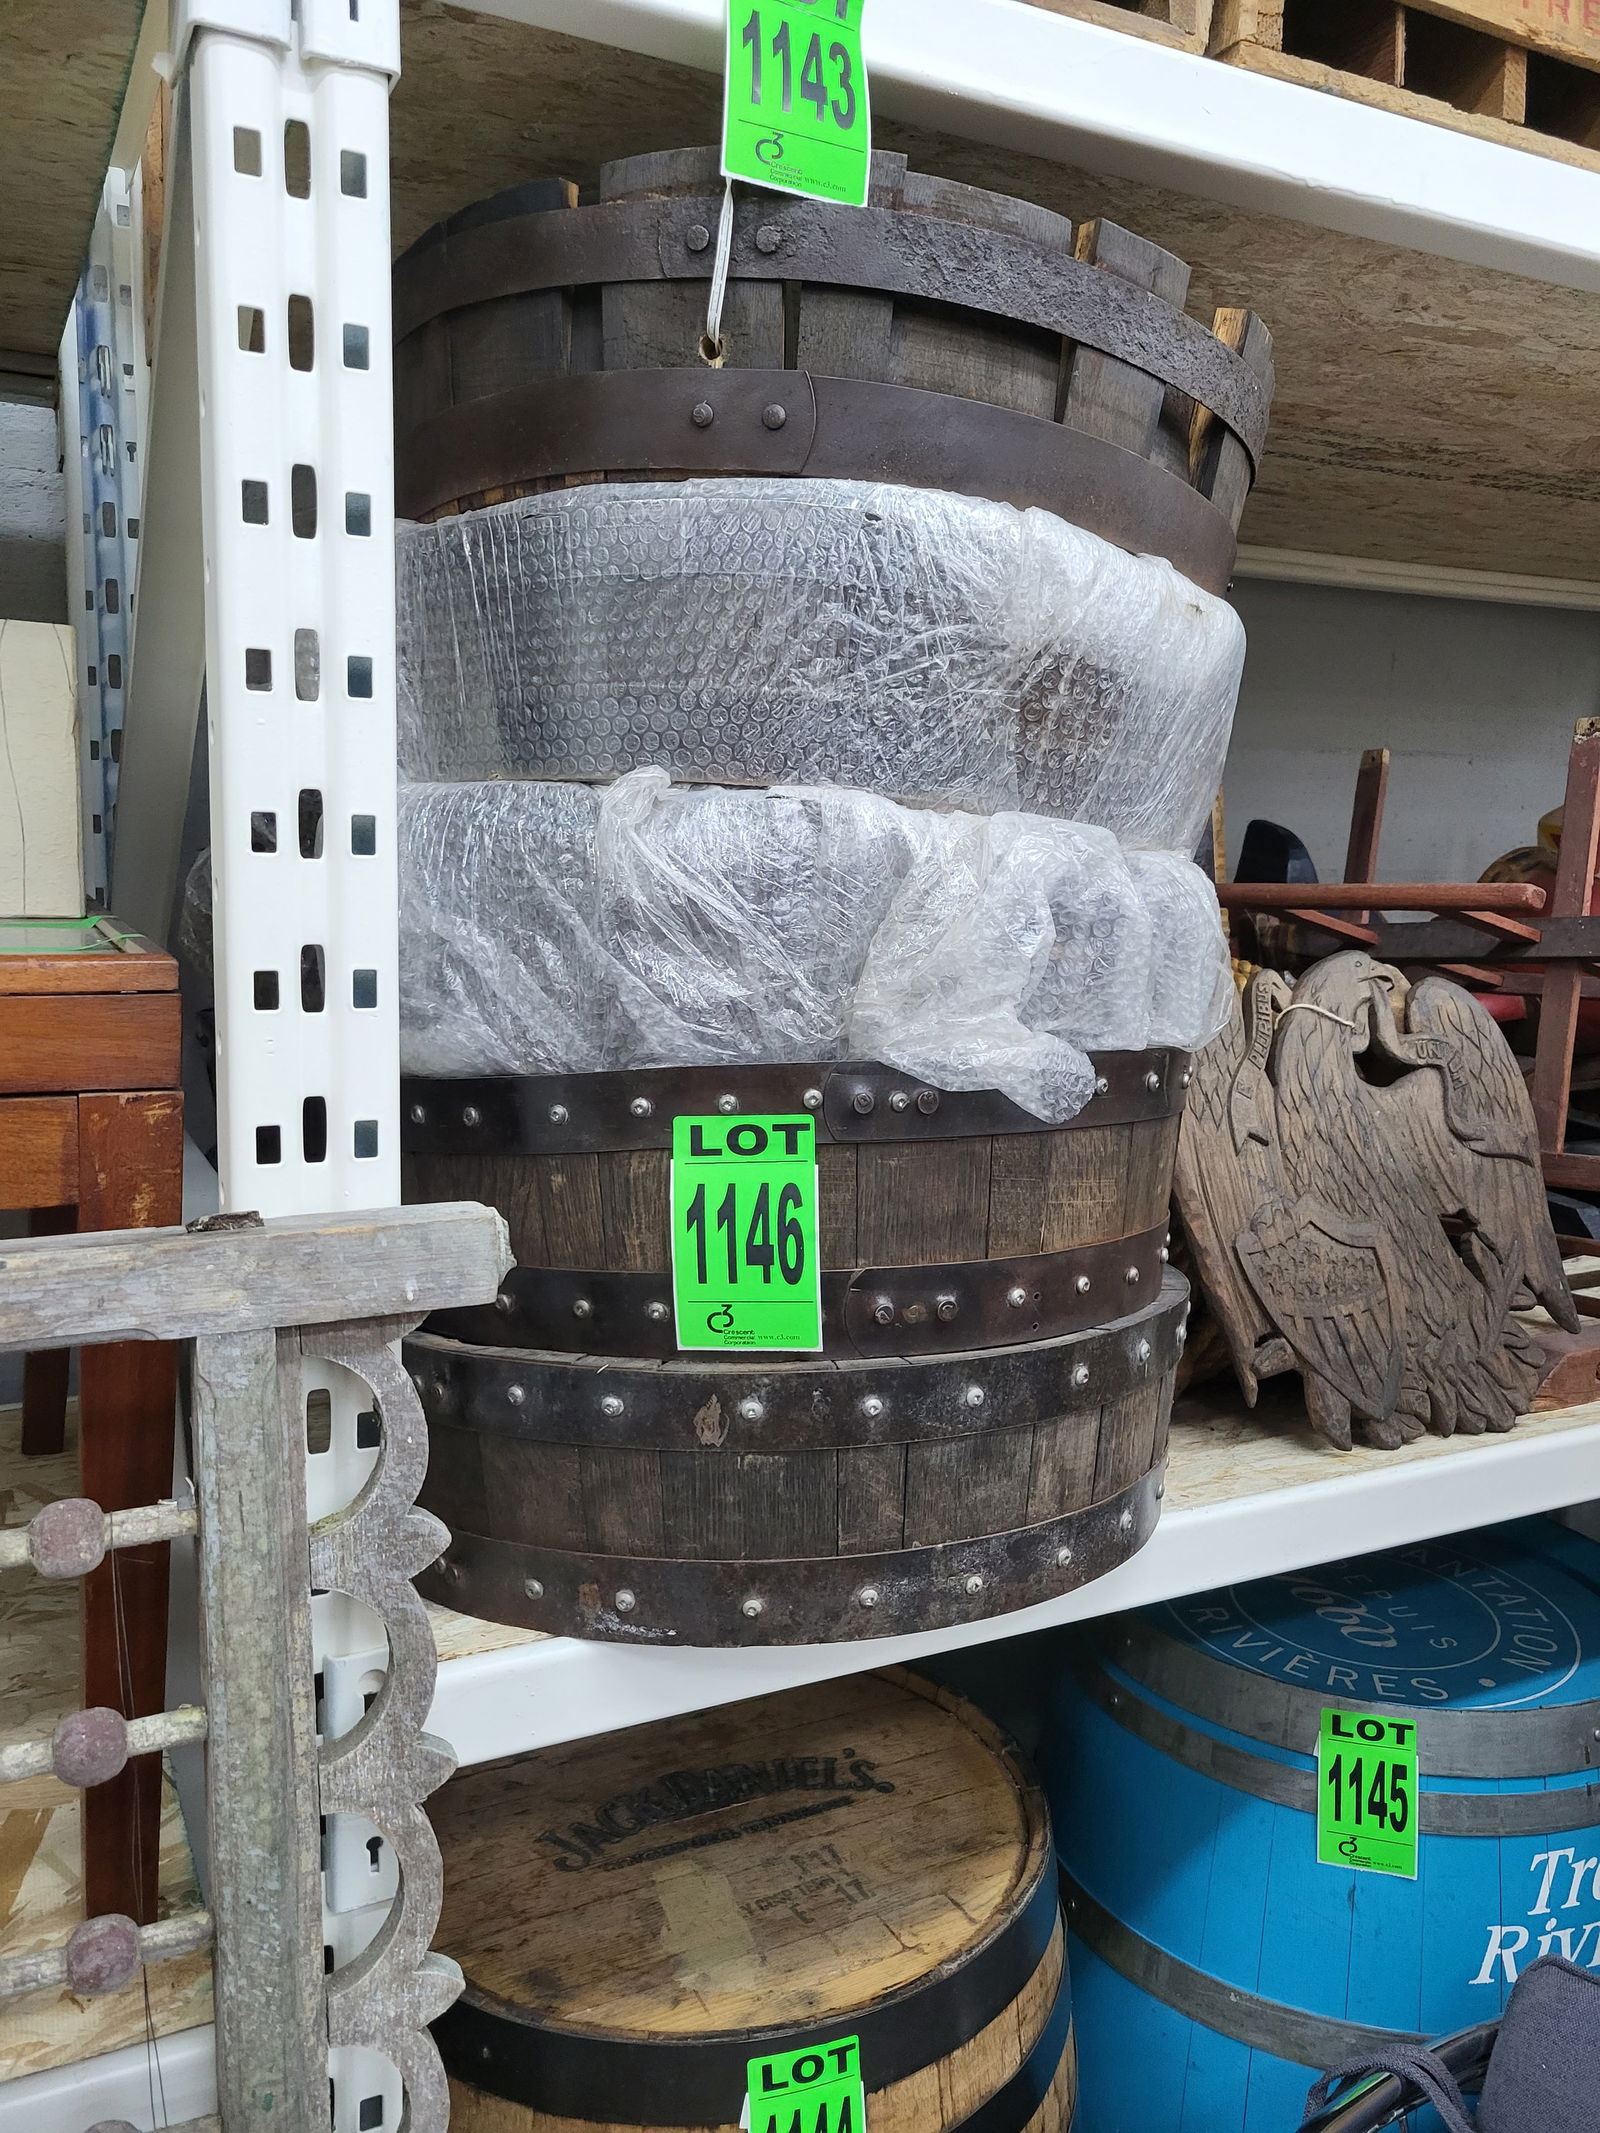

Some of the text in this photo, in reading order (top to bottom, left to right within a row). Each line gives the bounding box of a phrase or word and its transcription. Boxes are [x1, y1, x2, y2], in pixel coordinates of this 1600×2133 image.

[743, 10, 857, 130] 1143
[1247, 982, 1272, 1070] PLURIBUS
[690, 1123, 811, 1157] LOT
[687, 1182, 805, 1285] 1146
[757, 1333, 801, 1341] www.c3.com
[1188, 1606, 1450, 1701] RIVIÈRES
[1331, 1714, 1414, 1746] LOT
[536, 1785, 668, 1873] JACK
[1328, 1753, 1409, 1833] 1145
[761, 2043, 857, 2093] LOT
